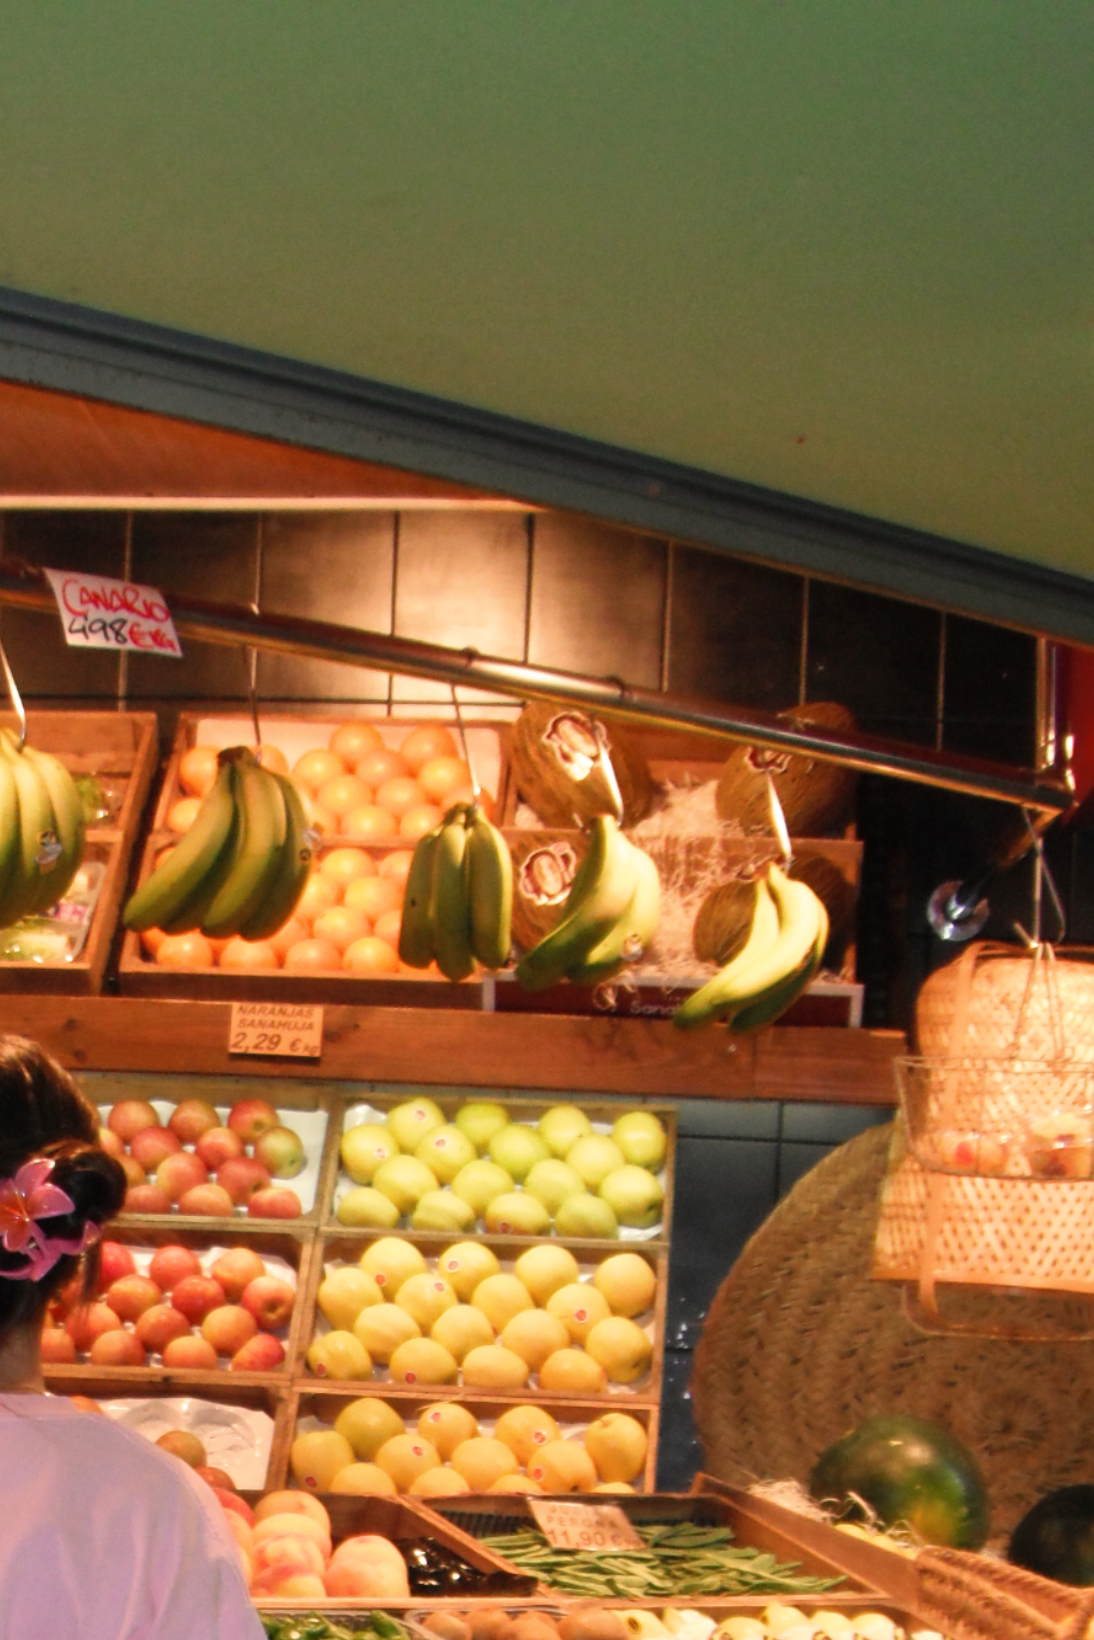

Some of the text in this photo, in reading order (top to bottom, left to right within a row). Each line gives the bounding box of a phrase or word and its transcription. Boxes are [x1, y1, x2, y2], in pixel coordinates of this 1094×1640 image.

[62, 578, 170, 623] CANARIO
[237, 1004, 315, 1019] NARANJAS
[230, 1031, 282, 1053] 2,29
[546, 1528, 606, 1549] 11,90
